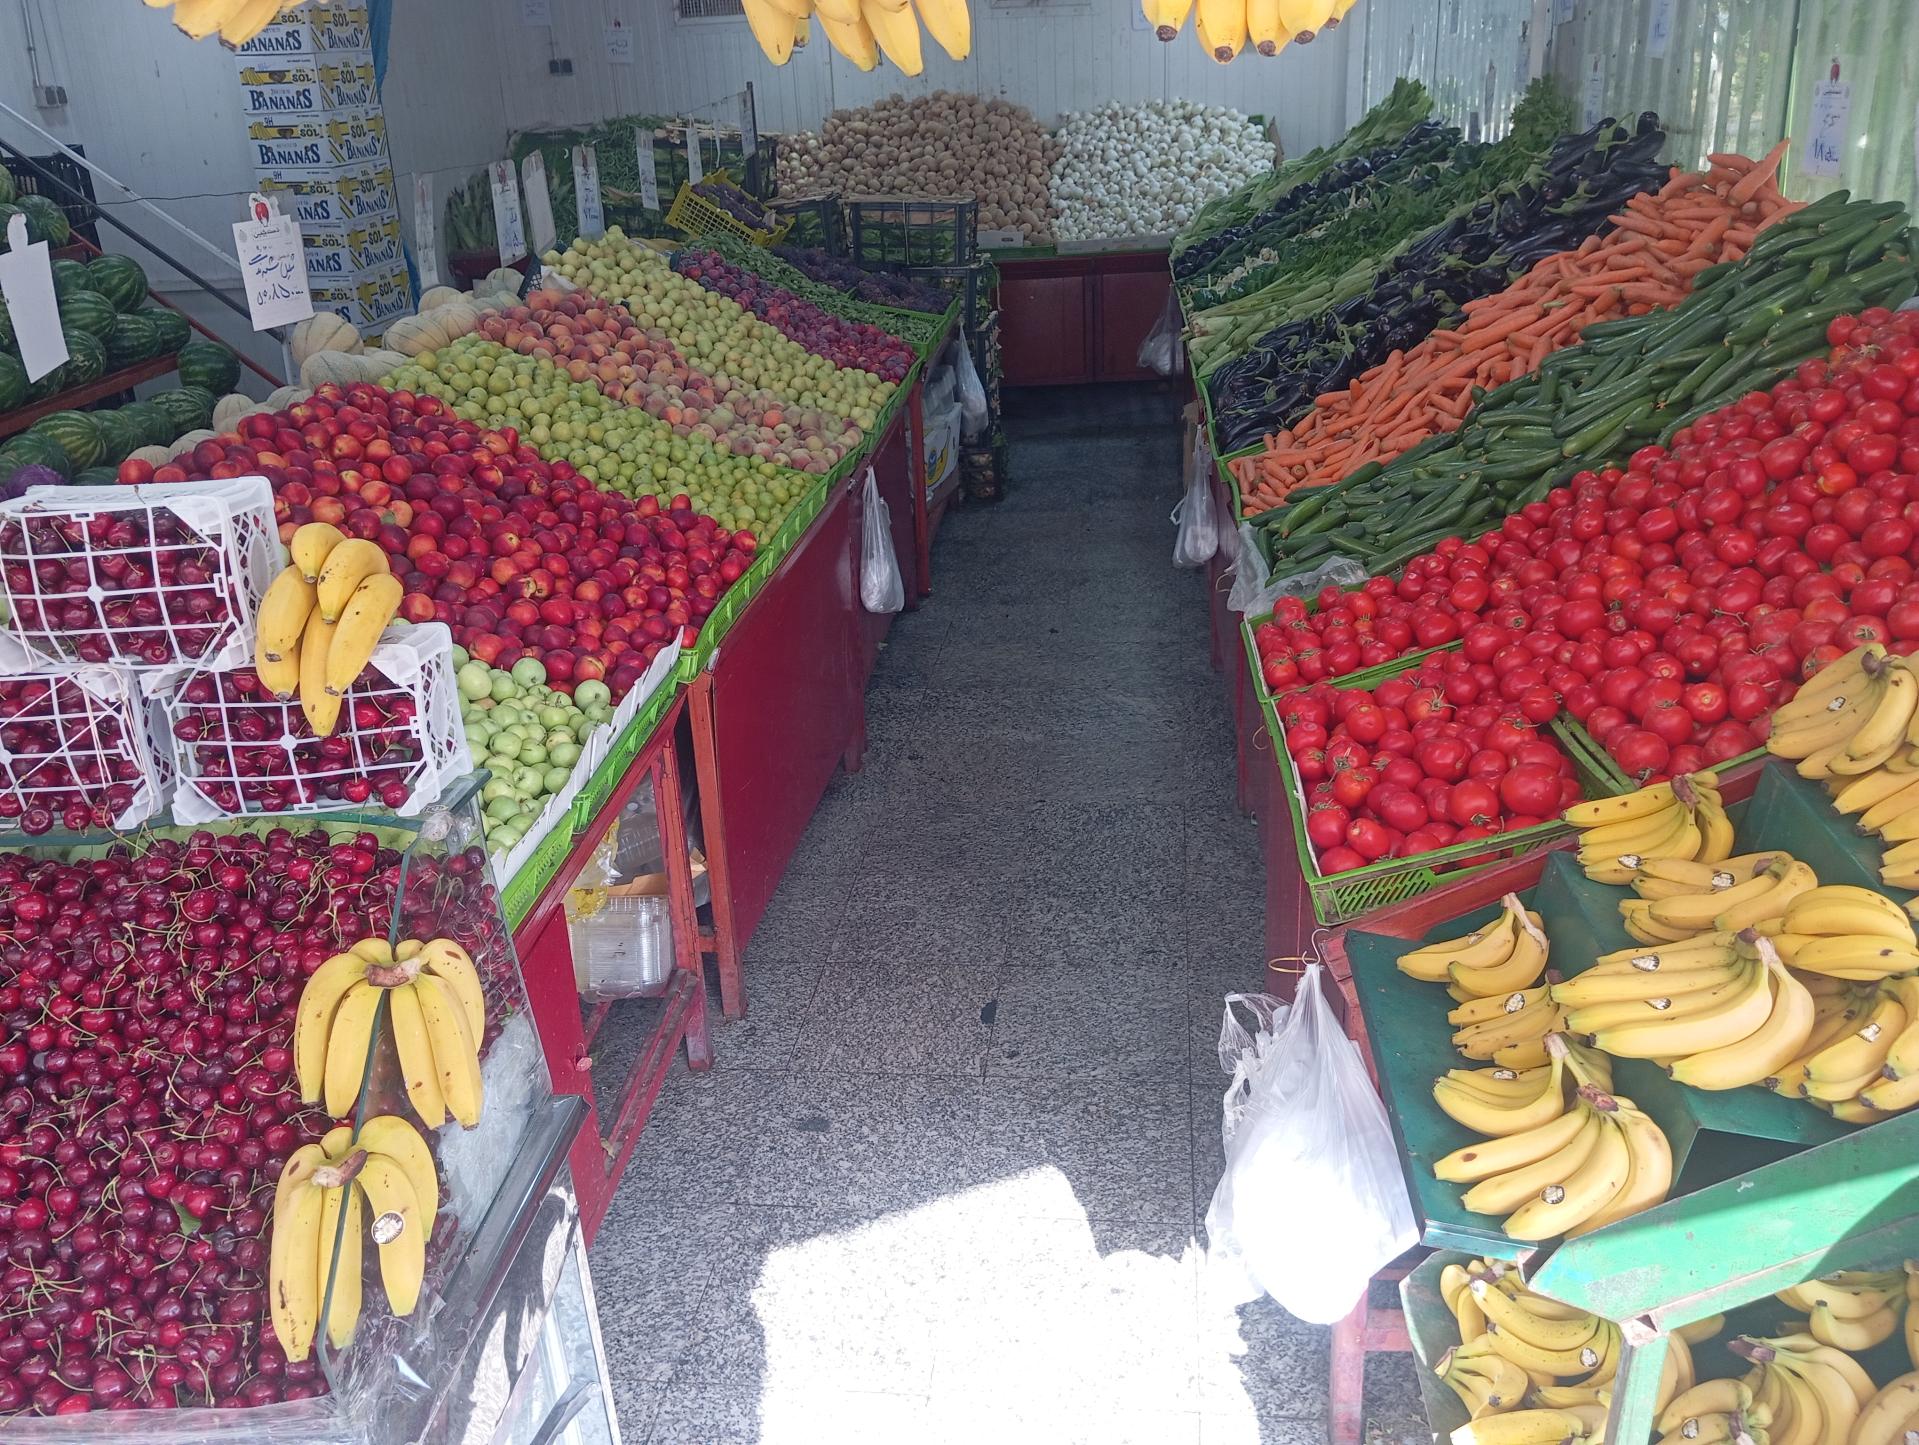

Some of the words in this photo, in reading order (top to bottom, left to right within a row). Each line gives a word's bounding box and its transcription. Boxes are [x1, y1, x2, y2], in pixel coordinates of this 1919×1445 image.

[281, 14, 302, 24] SOL
[332, 13, 350, 27] SOL
[292, 74, 313, 83] SOL
[340, 70, 357, 84] SOL
[249, 88, 313, 111] BANANAS
[300, 128, 320, 137] SOL
[350, 124, 367, 138] SOL
[258, 143, 321, 165] BANANAS
[310, 185, 330, 194] SOL
[360, 179, 376, 194] SOL
[322, 238, 342, 247] SOL
[368, 230, 384, 245] SOL
[331, 292, 351, 300] SOL
[378, 281, 394, 297] SOL
